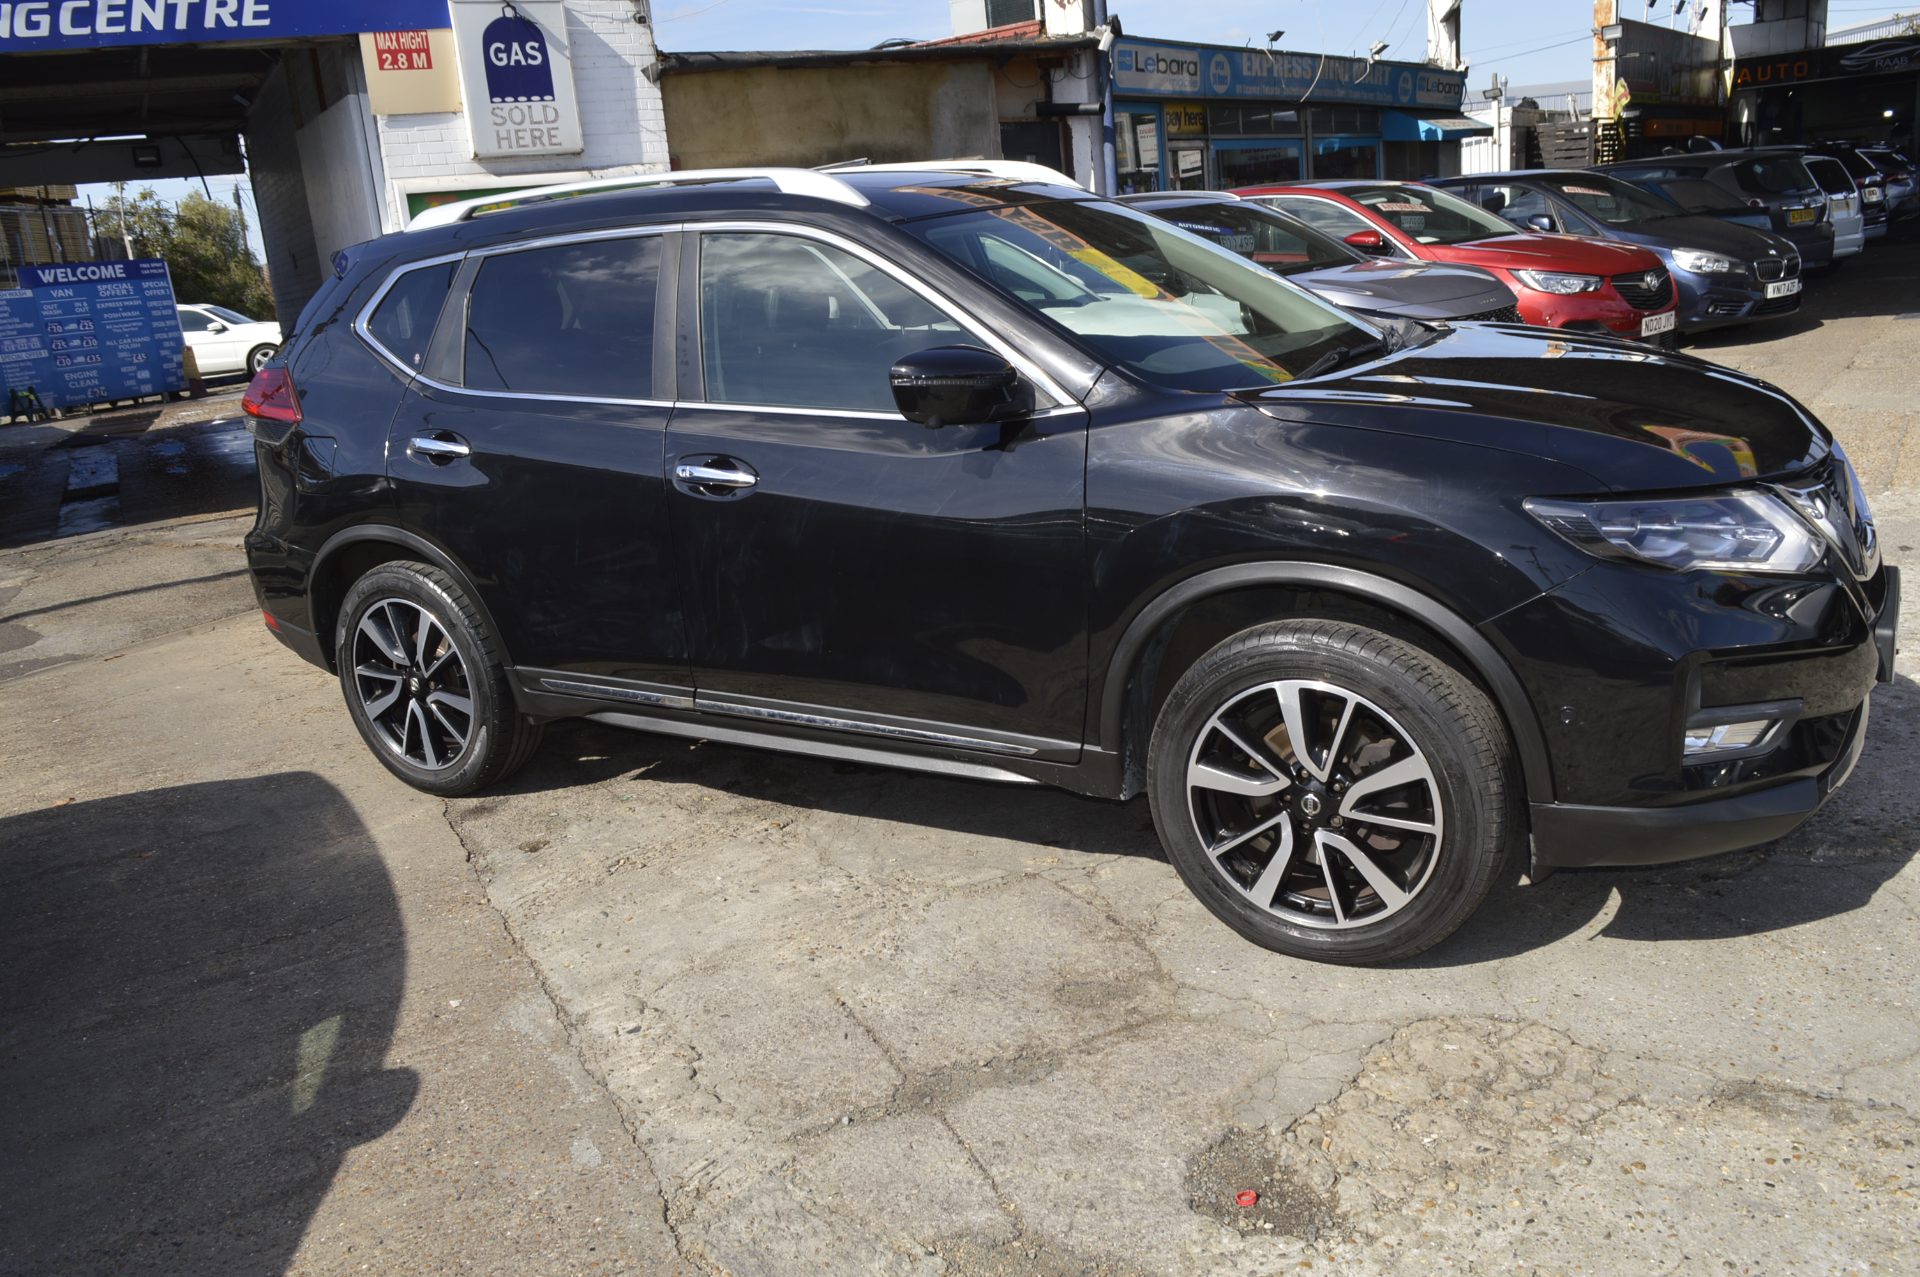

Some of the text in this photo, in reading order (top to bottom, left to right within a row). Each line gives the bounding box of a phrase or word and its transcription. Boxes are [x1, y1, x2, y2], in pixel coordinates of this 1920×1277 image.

[59, 0, 271, 35] CENTRE
[376, 31, 428, 50] MAX HIGHT
[382, 52, 428, 69] 2.8 M
[489, 41, 543, 67] GAS
[1134, 50, 1198, 76] Lebara
[1242, 53, 1312, 79] EXPRESS
[1314, 57, 1350, 82] MINI
[1353, 60, 1392, 87] MART
[1739, 60, 1809, 81] AUTO
[1426, 78, 1460, 95] Lebara
[490, 104, 560, 127] SOLD
[1166, 105, 1206, 130] pay here
[495, 127, 562, 149] HERE
[1178, 222, 1221, 233] AUTOMATIC
[37, 264, 126, 283] WELCOME
[50, 288, 74, 298] VAN
[97, 282, 134, 292] SPECIAL
[99, 289, 127, 297] OFFER
[96, 301, 124, 309] EXPRESS
[87, 354, 102, 363] £35
[64, 370, 98, 380] ENGINE
[68, 379, 99, 389] CLEAN
